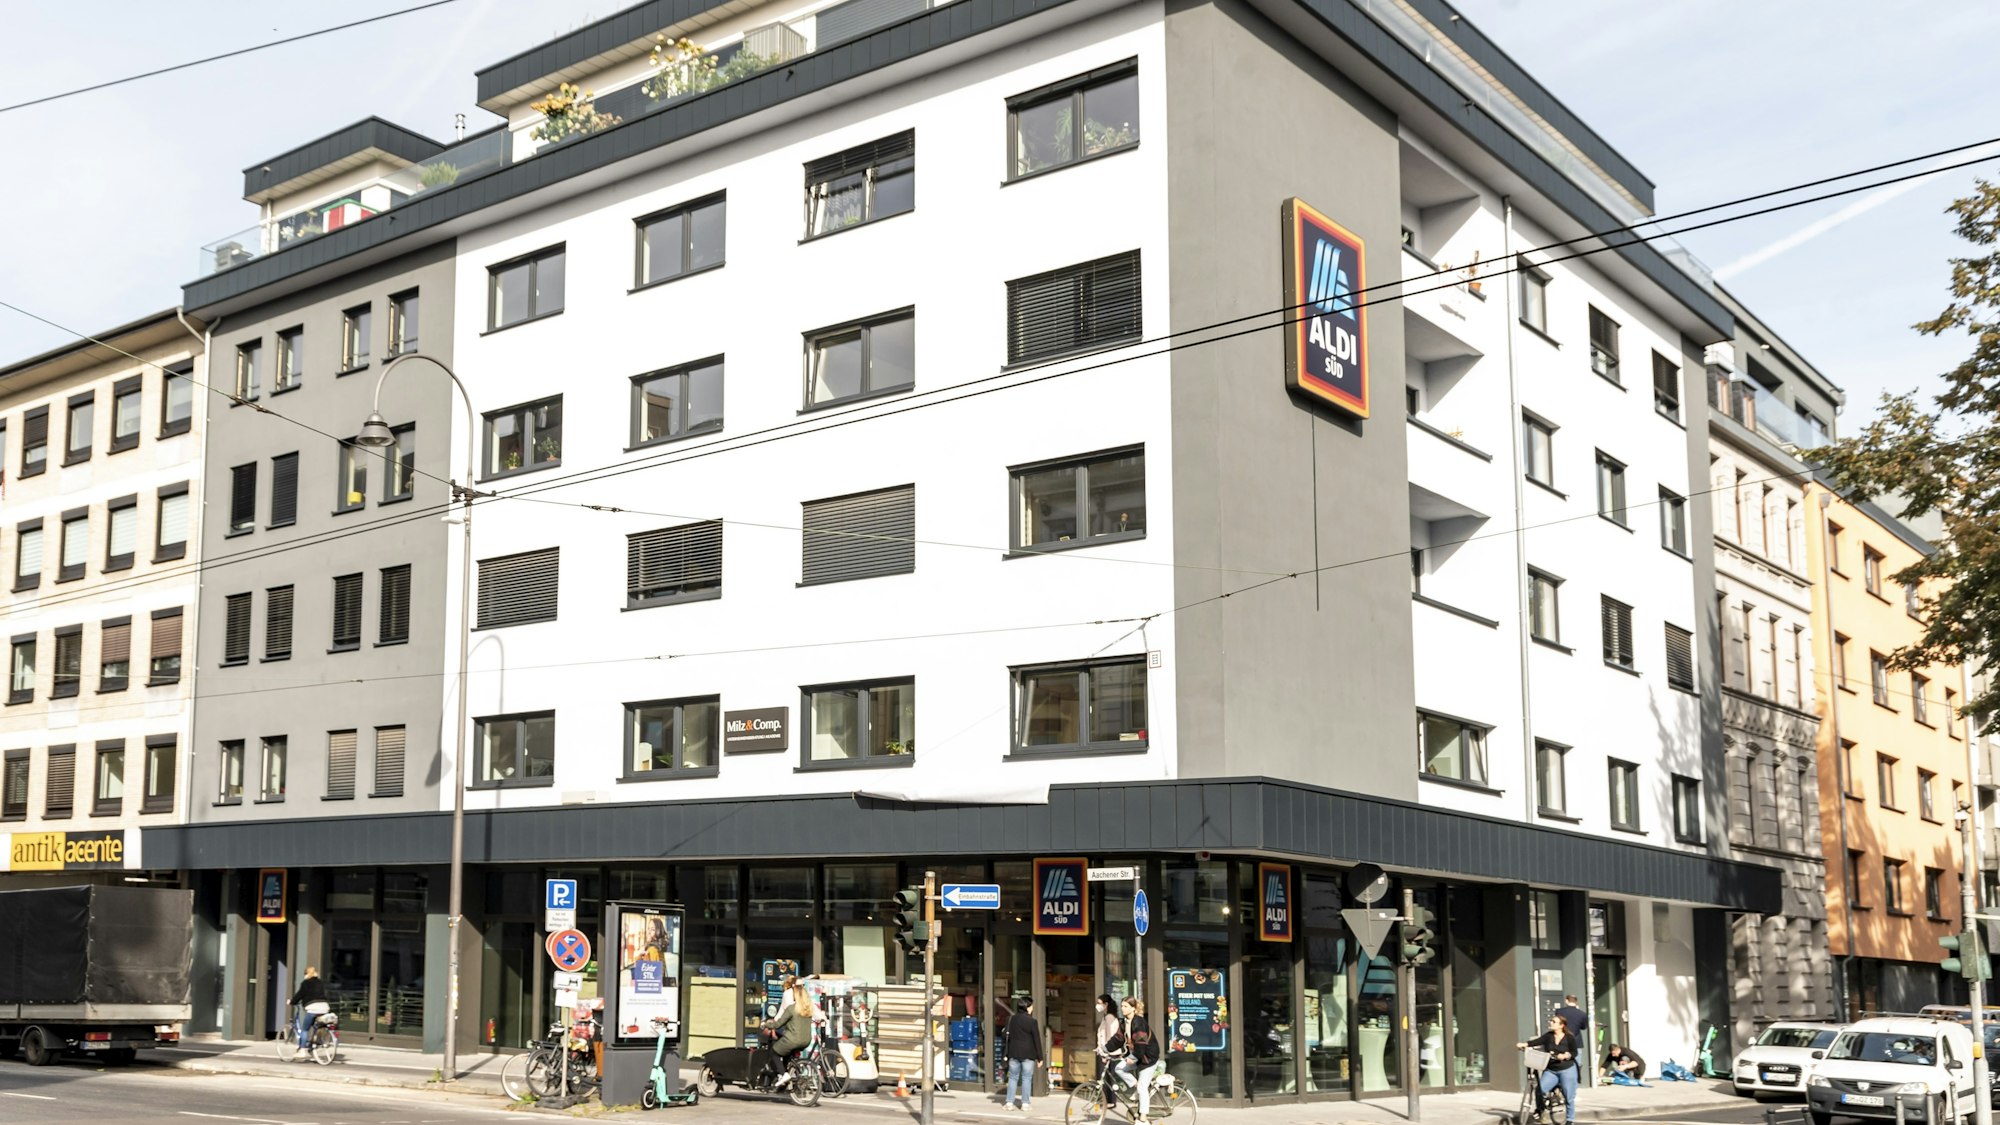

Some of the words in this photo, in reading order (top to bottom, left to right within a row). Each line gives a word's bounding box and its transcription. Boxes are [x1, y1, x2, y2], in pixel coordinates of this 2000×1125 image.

[1309, 313, 1357, 366] ALDI
[1325, 355, 1344, 379] SÜD
[727, 719, 782, 732] Milz&Comp.
[14, 835, 62, 863] antik
[1092, 871, 1119, 879] Aachener
[1120, 870, 1131, 878] Str.
[553, 883, 570, 906] P
[262, 898, 281, 909] ALDI
[1043, 901, 1079, 915] ALDI
[1054, 915, 1068, 924] SÜD
[1266, 908, 1287, 921] ALDI
